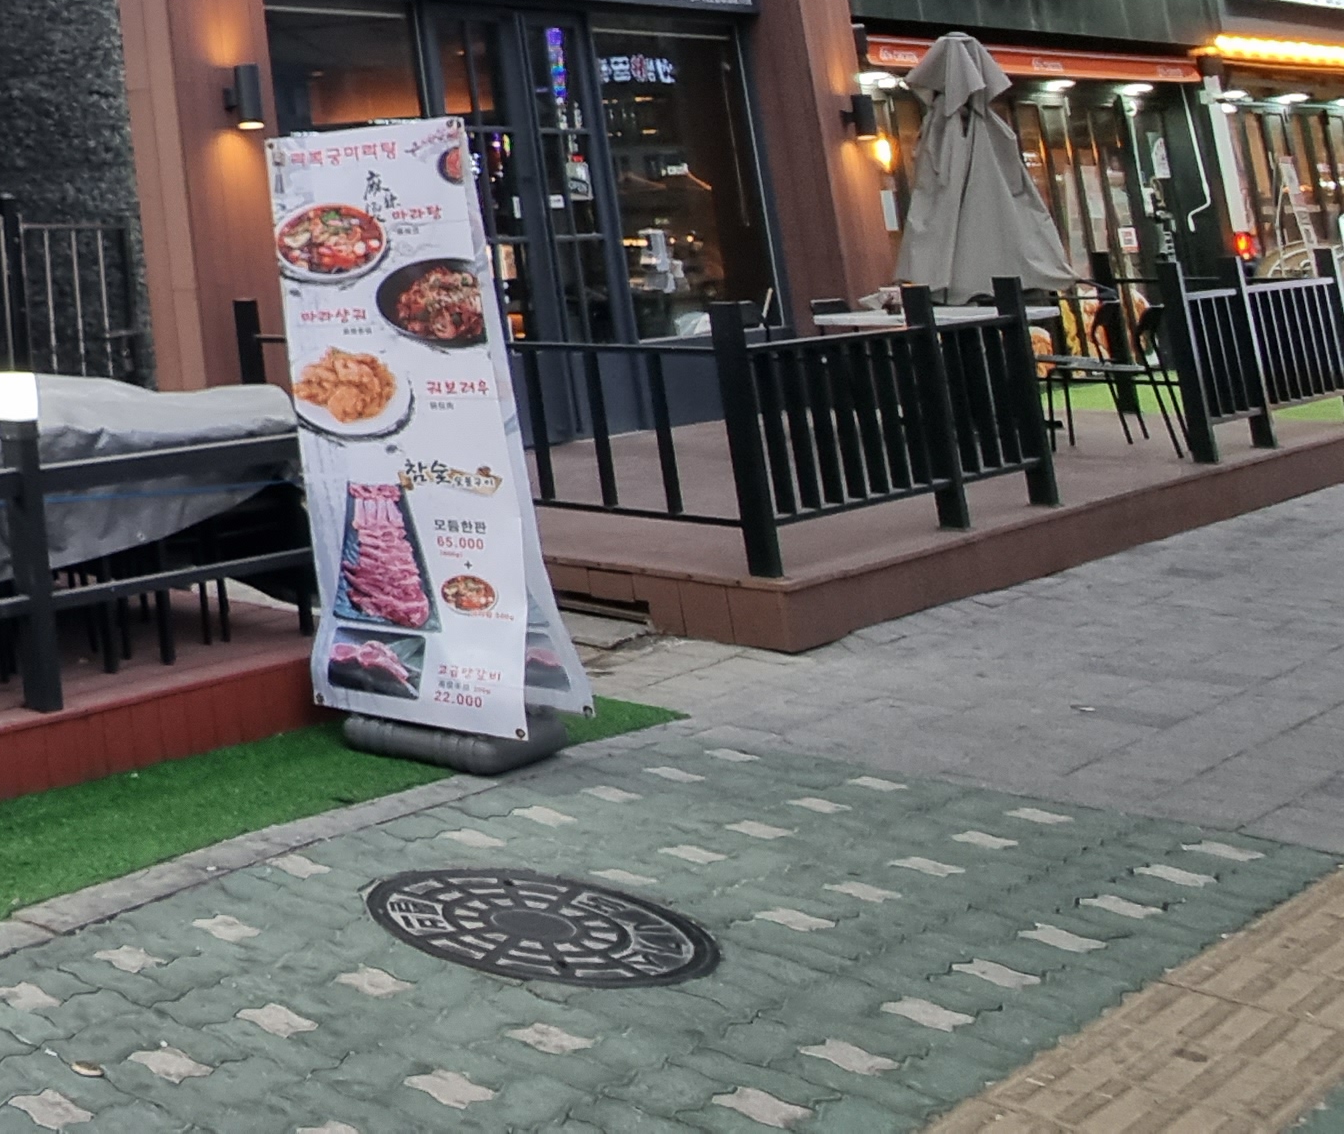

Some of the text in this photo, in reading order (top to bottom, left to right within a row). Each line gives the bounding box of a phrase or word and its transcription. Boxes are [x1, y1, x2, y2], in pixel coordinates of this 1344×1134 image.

[392, 204, 442, 220] 마라탕
[404, 458, 451, 484] 참숯
[434, 518, 487, 535] 모듬한판
[434, 690, 483, 709] 22.000
